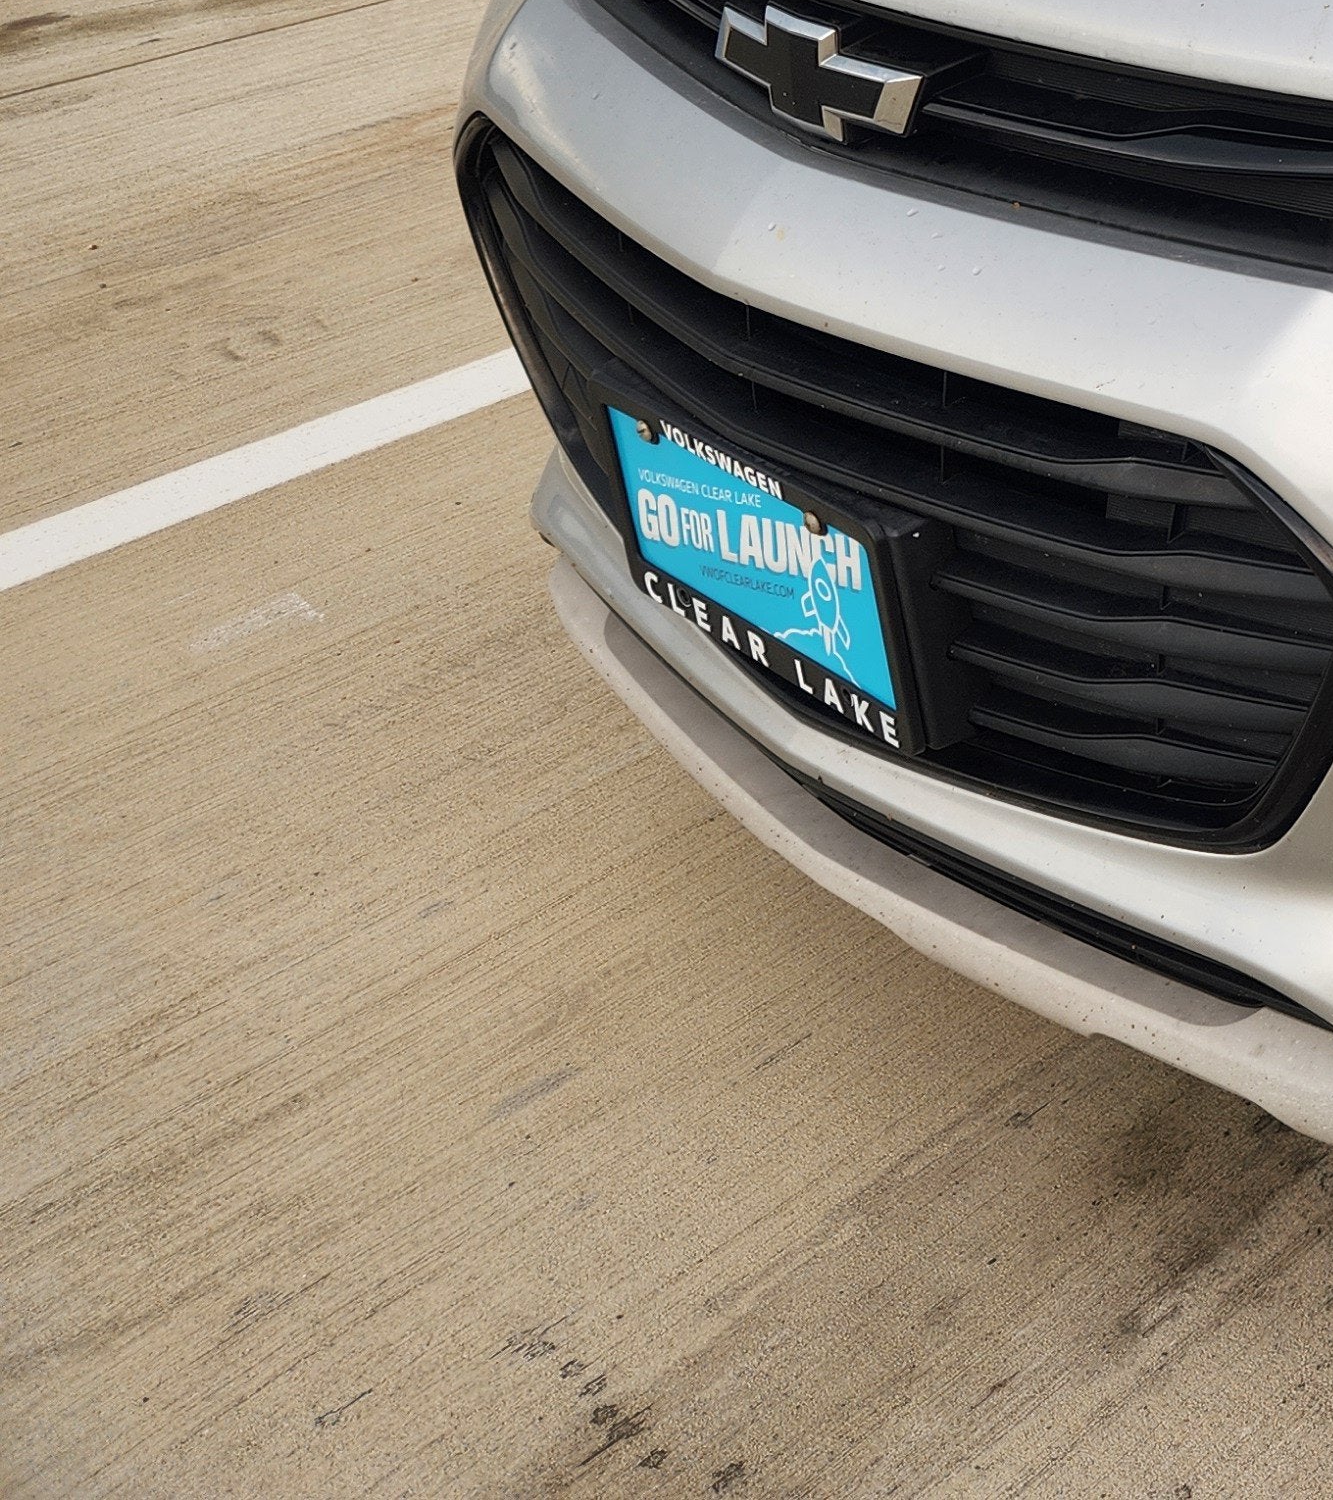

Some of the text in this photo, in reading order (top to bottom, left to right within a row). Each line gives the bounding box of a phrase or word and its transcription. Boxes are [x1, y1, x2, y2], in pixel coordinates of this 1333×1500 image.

[638, 468, 762, 509] VOLKSWAGEN CLEAR LAKE
[659, 419, 783, 500] VOLKSWAGEN
[637, 488, 862, 591] GO FOR LAUNCH
[644, 571, 900, 748] CLEAR LAKE
